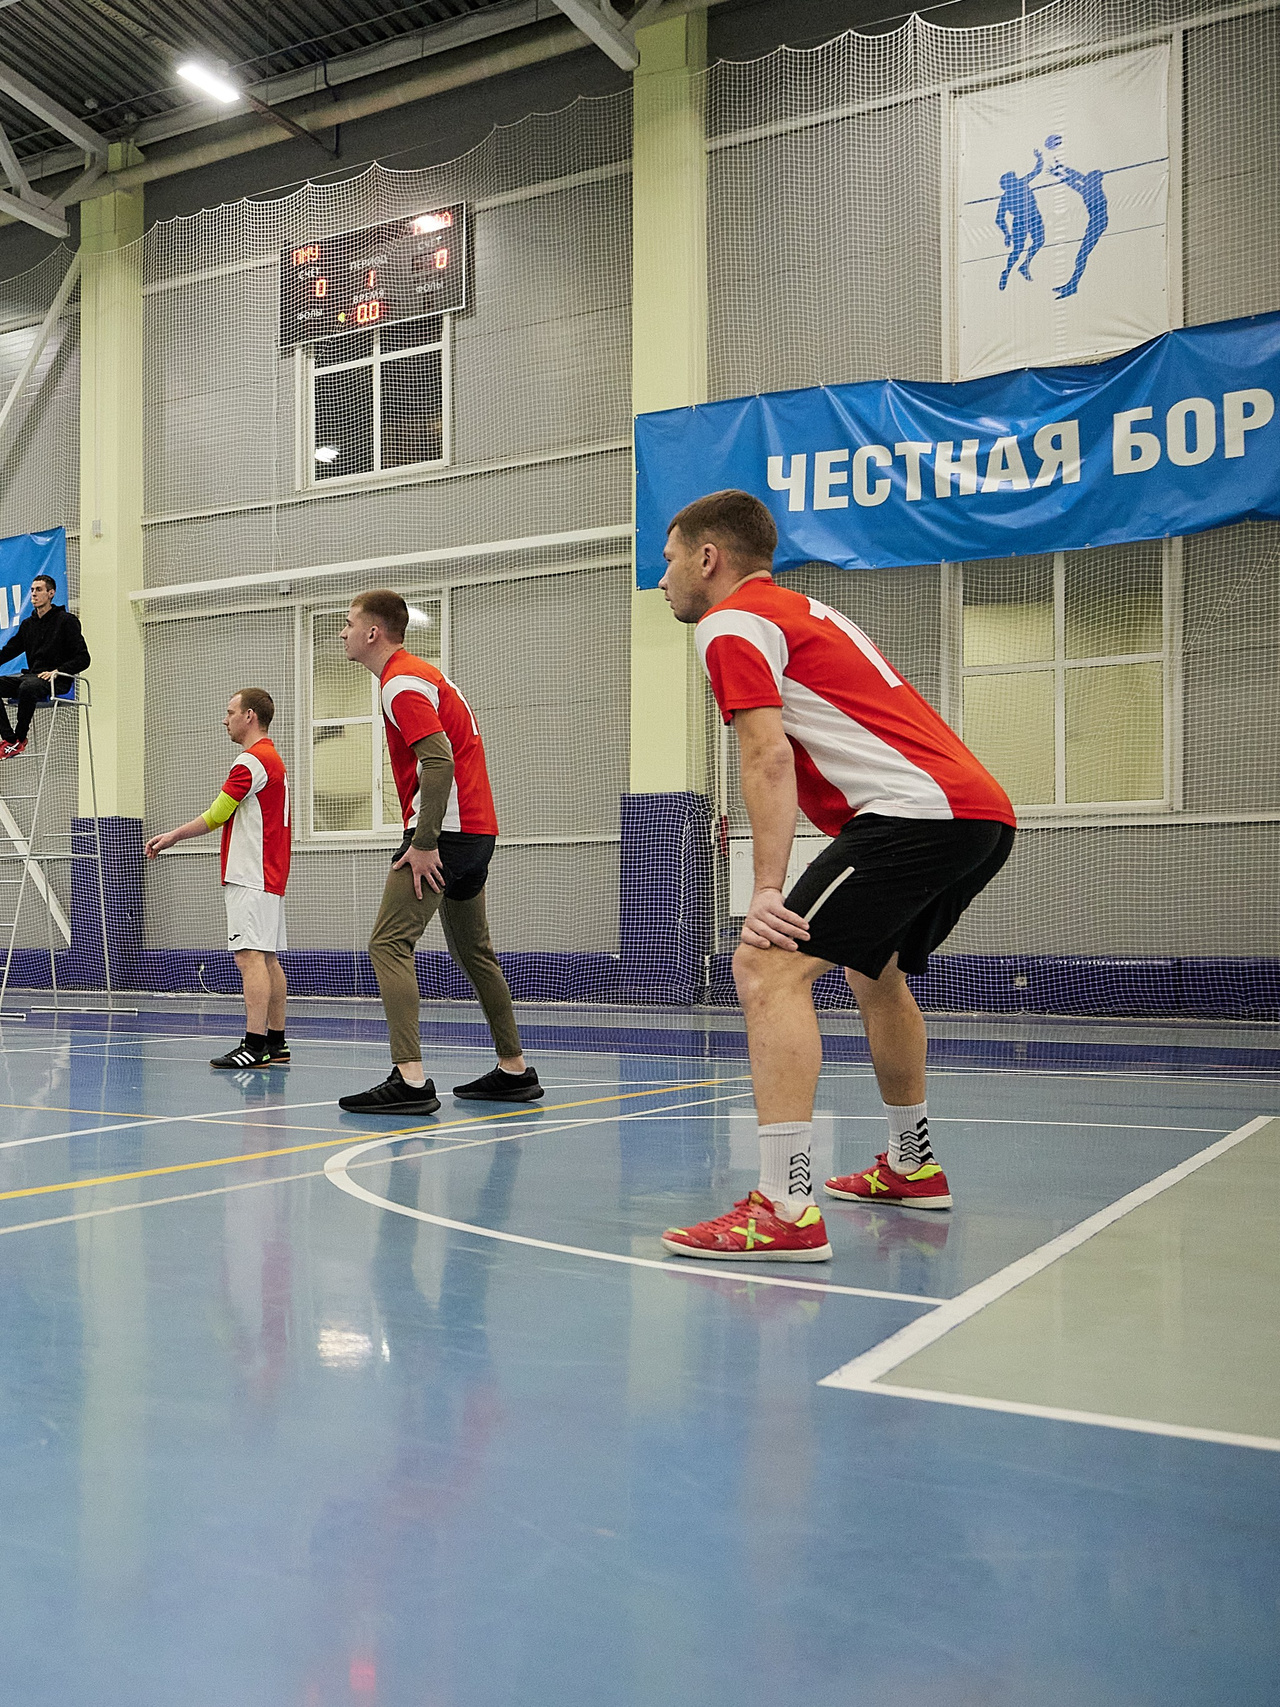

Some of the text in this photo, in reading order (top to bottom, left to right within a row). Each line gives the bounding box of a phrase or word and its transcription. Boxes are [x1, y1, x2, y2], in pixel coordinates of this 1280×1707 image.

[350, 254, 388, 270] ПЕРИОД
[436, 248, 448, 269] 0
[315, 279, 327, 297] 0
[416, 280, 444, 293] ФОЛЫ
[353, 289, 385, 304] ВРЕМЯ
[297, 309, 323, 320] ФОЛЫ
[767, 388, 1275, 512] ЧЕСТНАЯ БОР
[806, 596, 904, 689] 1
